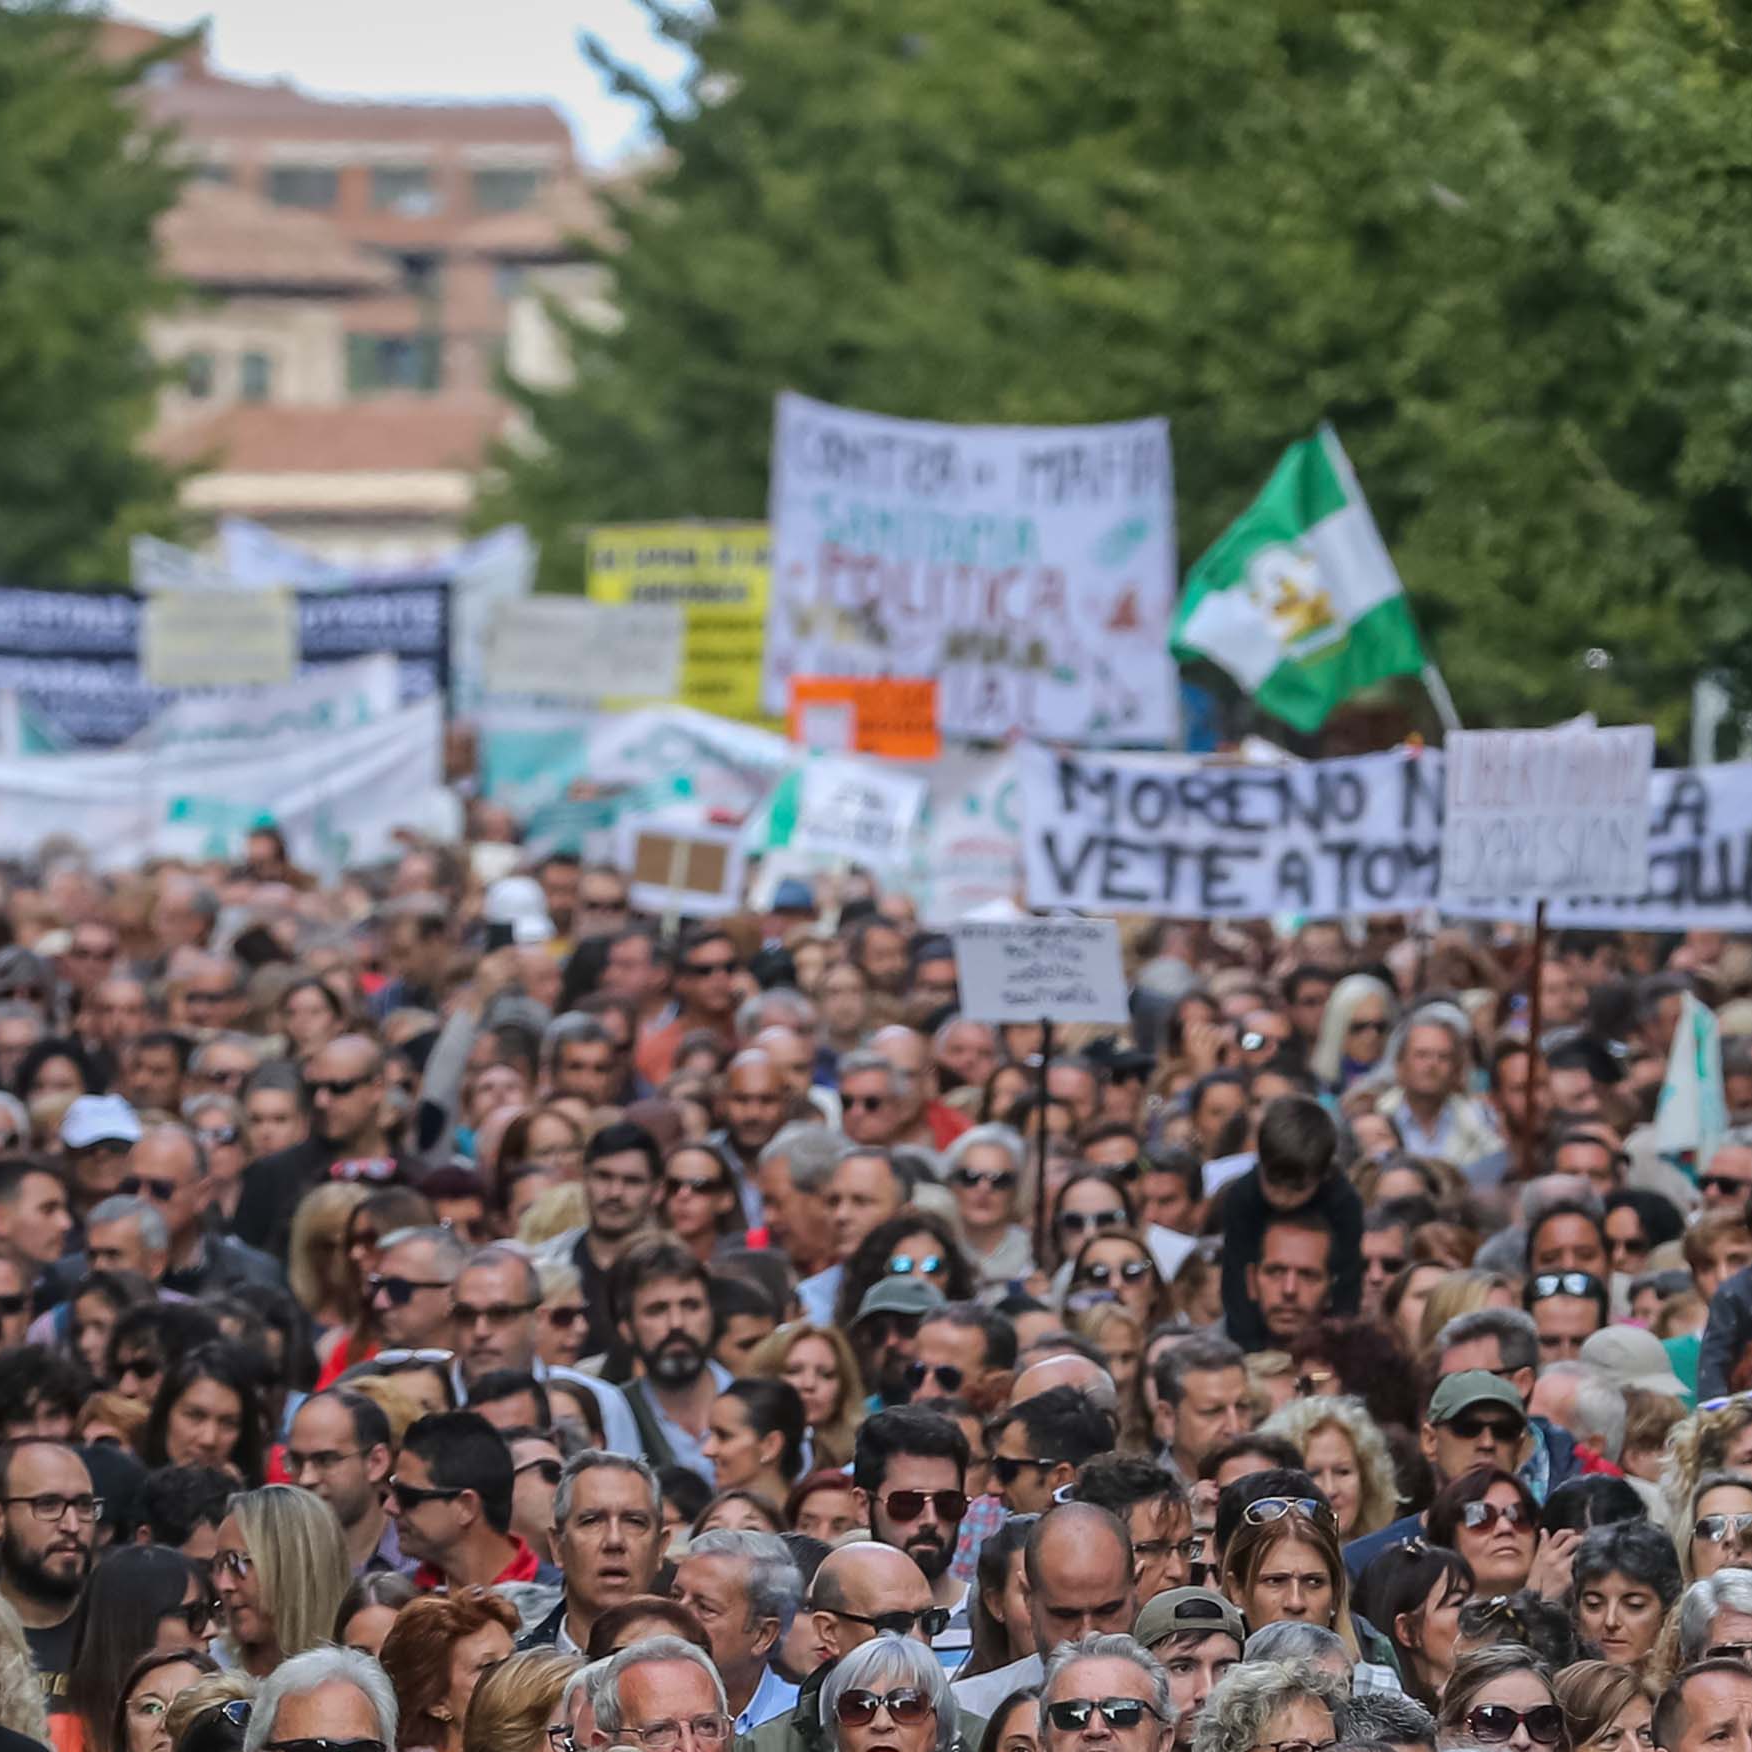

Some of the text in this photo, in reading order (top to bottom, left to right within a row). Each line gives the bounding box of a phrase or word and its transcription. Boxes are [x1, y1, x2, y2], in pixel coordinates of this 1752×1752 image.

[1055, 757, 1366, 832] MORENO
[1044, 830, 1262, 907] VETE
[1277, 846, 1314, 908] A
